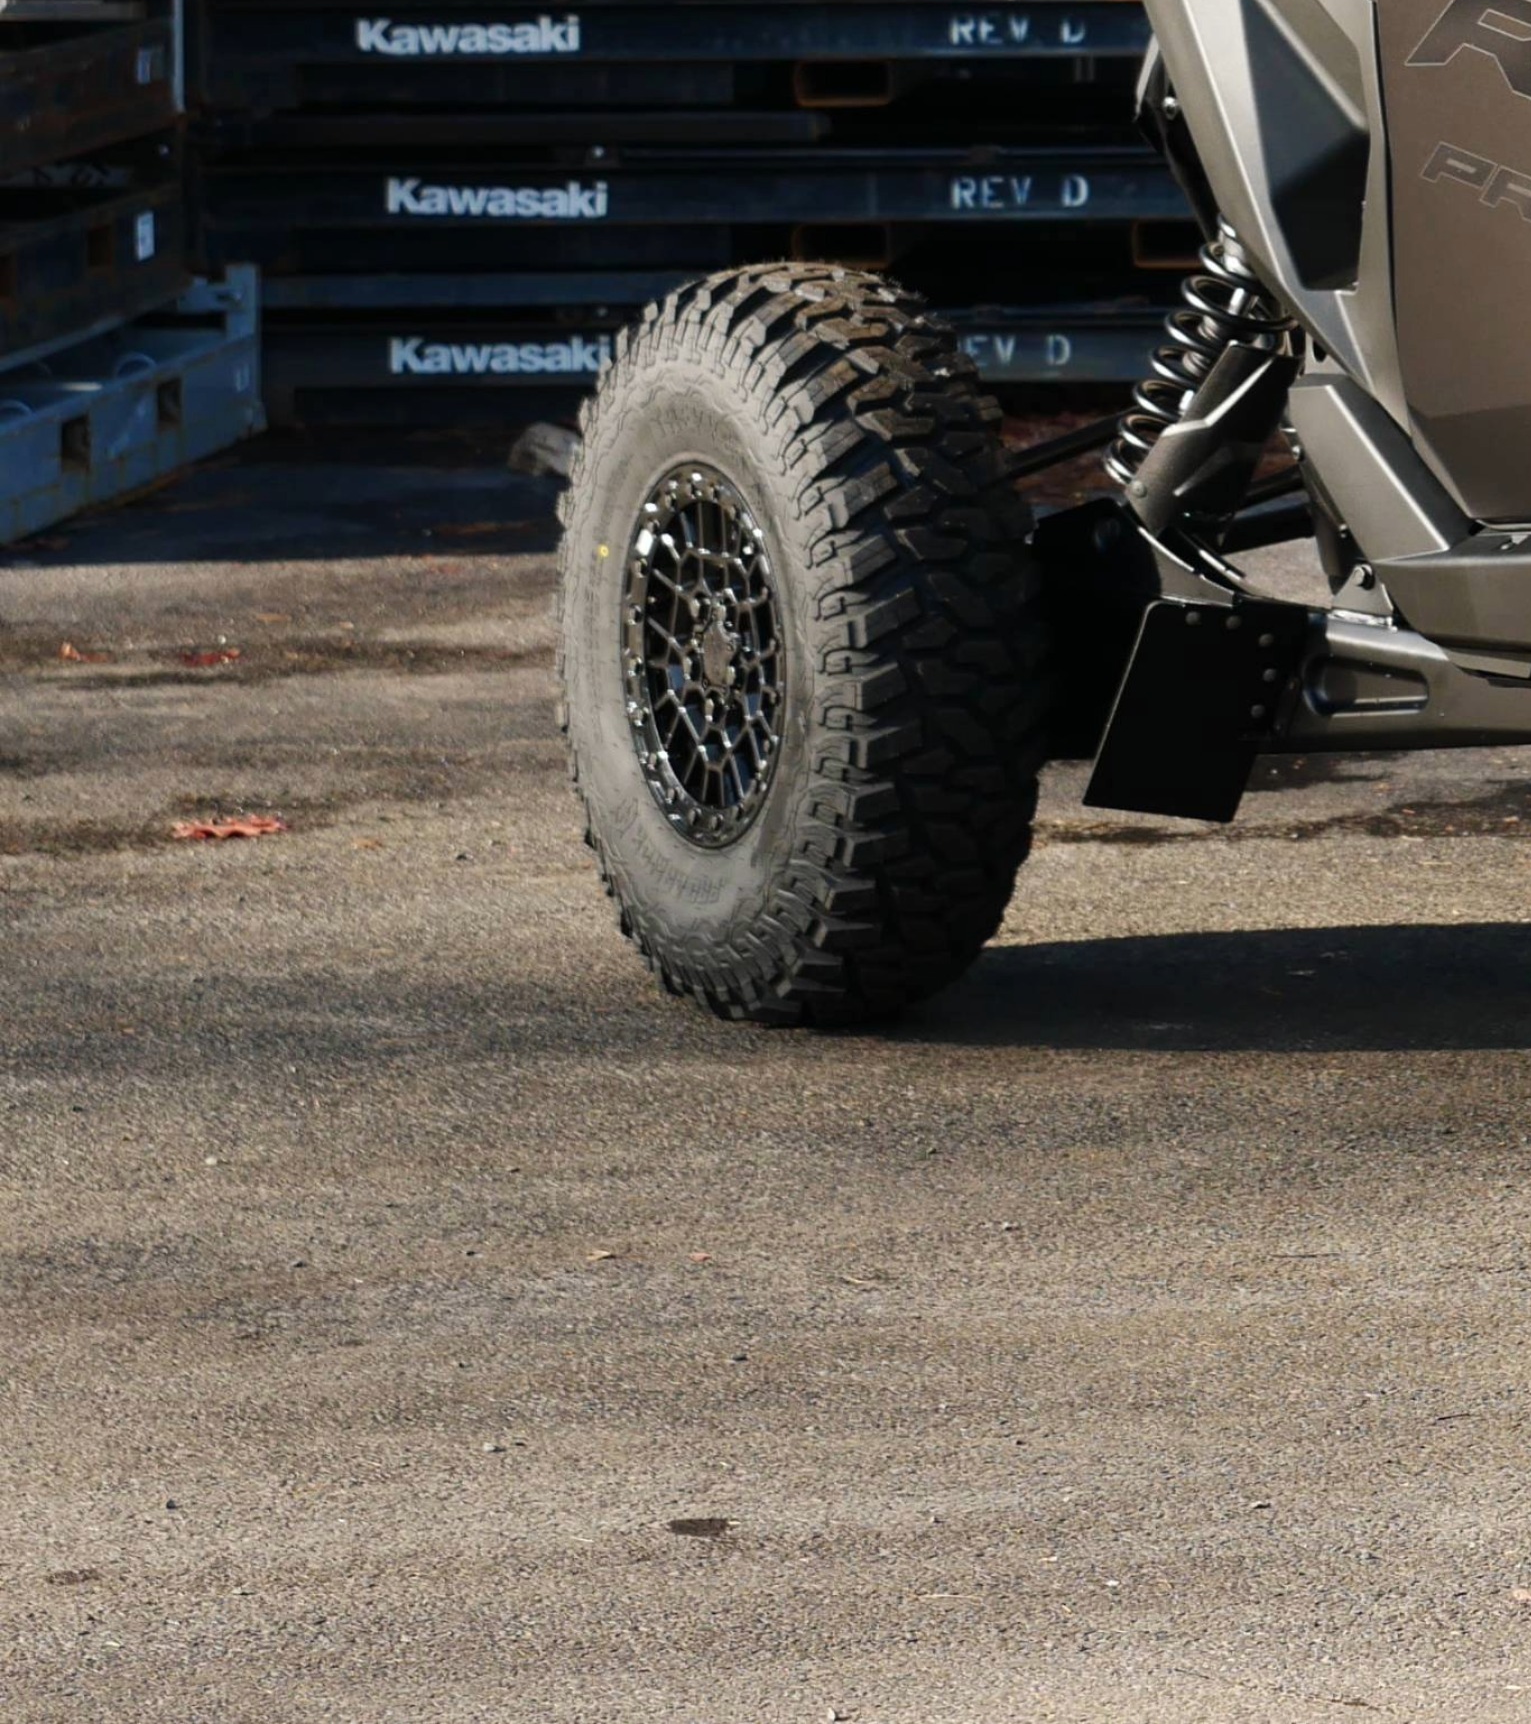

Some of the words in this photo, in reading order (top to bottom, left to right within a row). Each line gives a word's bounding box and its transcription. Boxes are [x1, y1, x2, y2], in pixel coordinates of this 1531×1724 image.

[357, 14, 580, 55] Kawasaki
[950, 14, 1029, 45] REV
[387, 178, 608, 218] Kawasaki
[951, 175, 1032, 209] REV
[1061, 173, 1090, 208] D
[389, 334, 613, 375] Kawasaki
[957, 334, 1016, 367] EV
[1045, 333, 1072, 366] D
